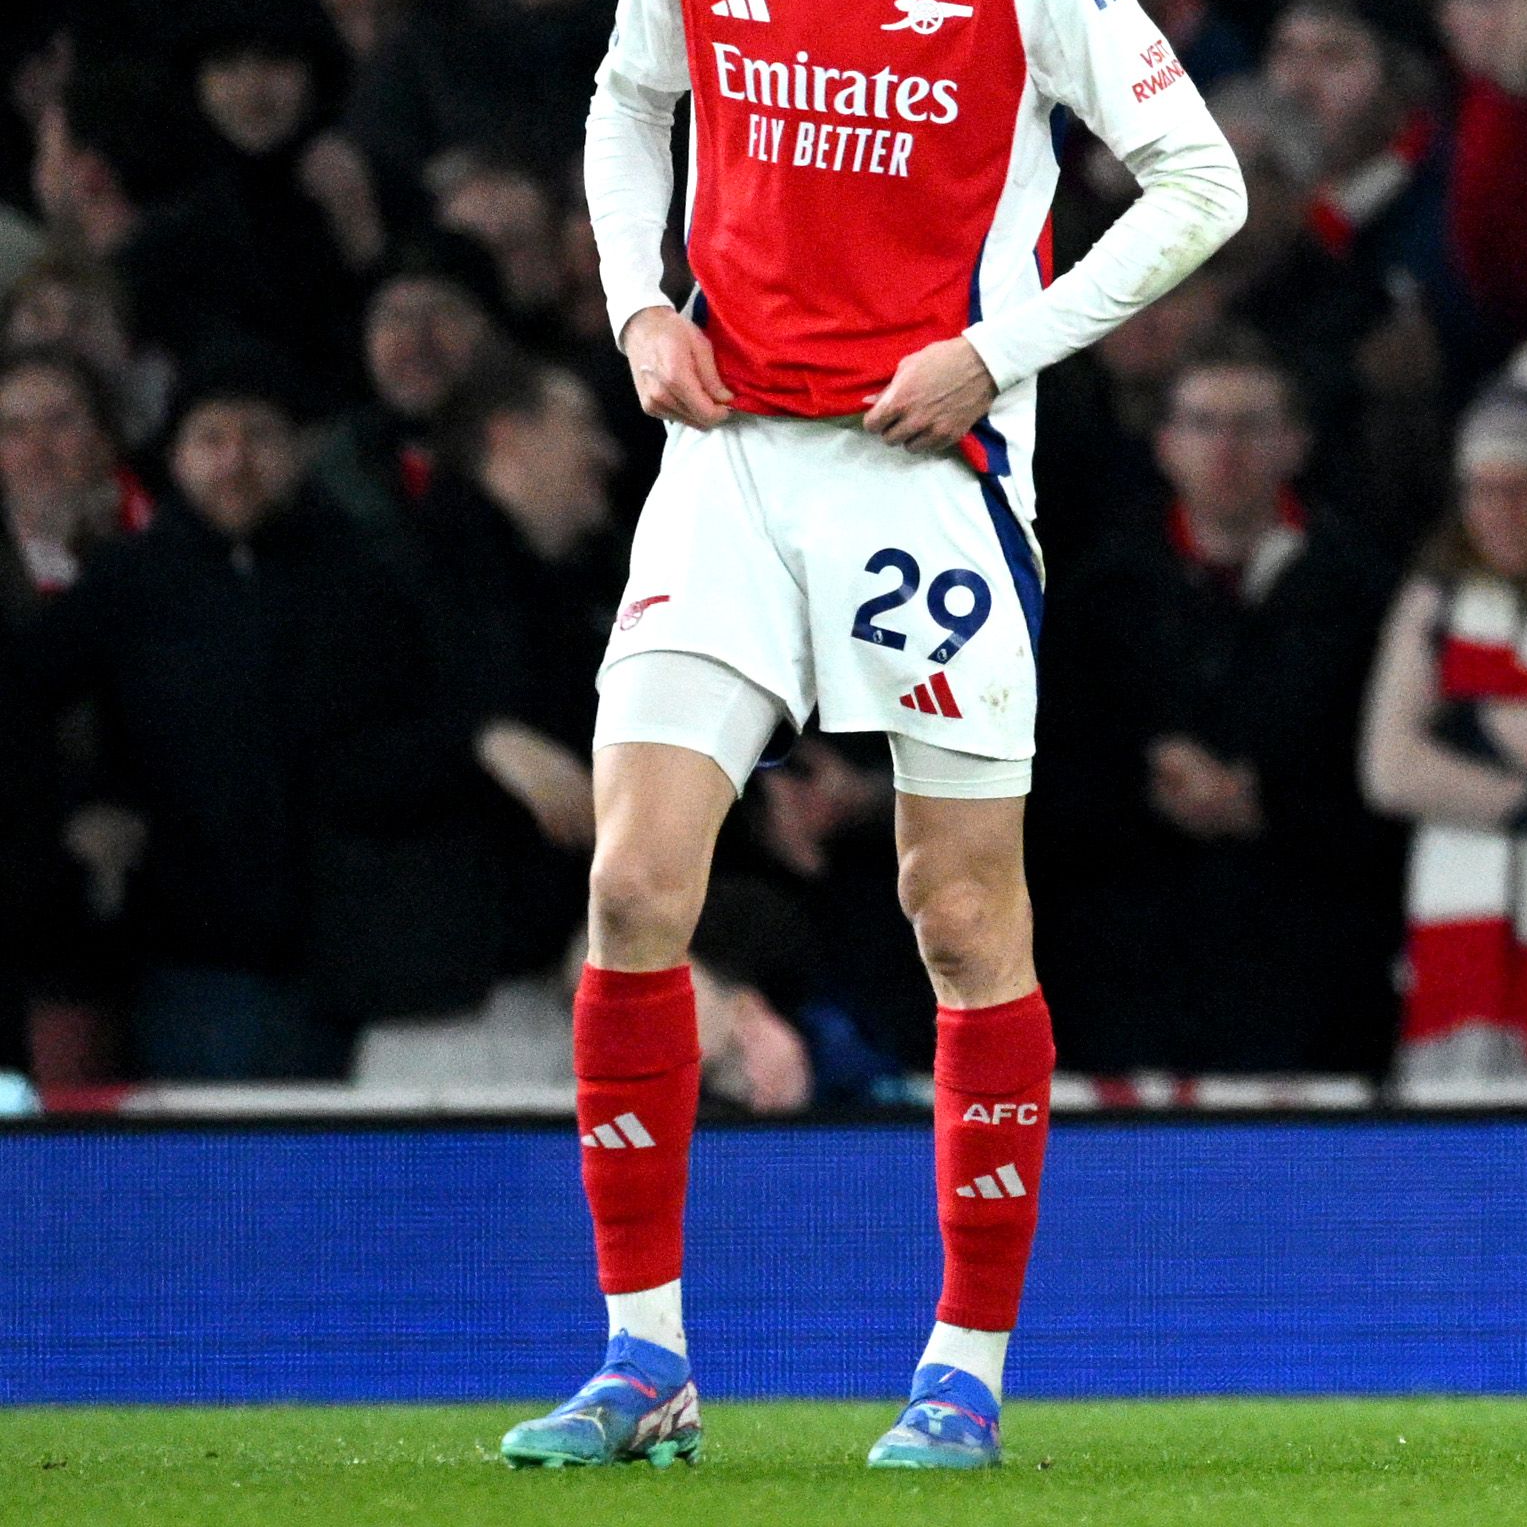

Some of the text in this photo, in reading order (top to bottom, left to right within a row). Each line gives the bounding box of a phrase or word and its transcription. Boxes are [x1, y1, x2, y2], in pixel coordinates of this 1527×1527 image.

[712, 41, 959, 125] Emirates
[748, 113, 914, 178] FLY BETTER
[851, 548, 992, 665] 29
[962, 1103, 1038, 1126] AFC
